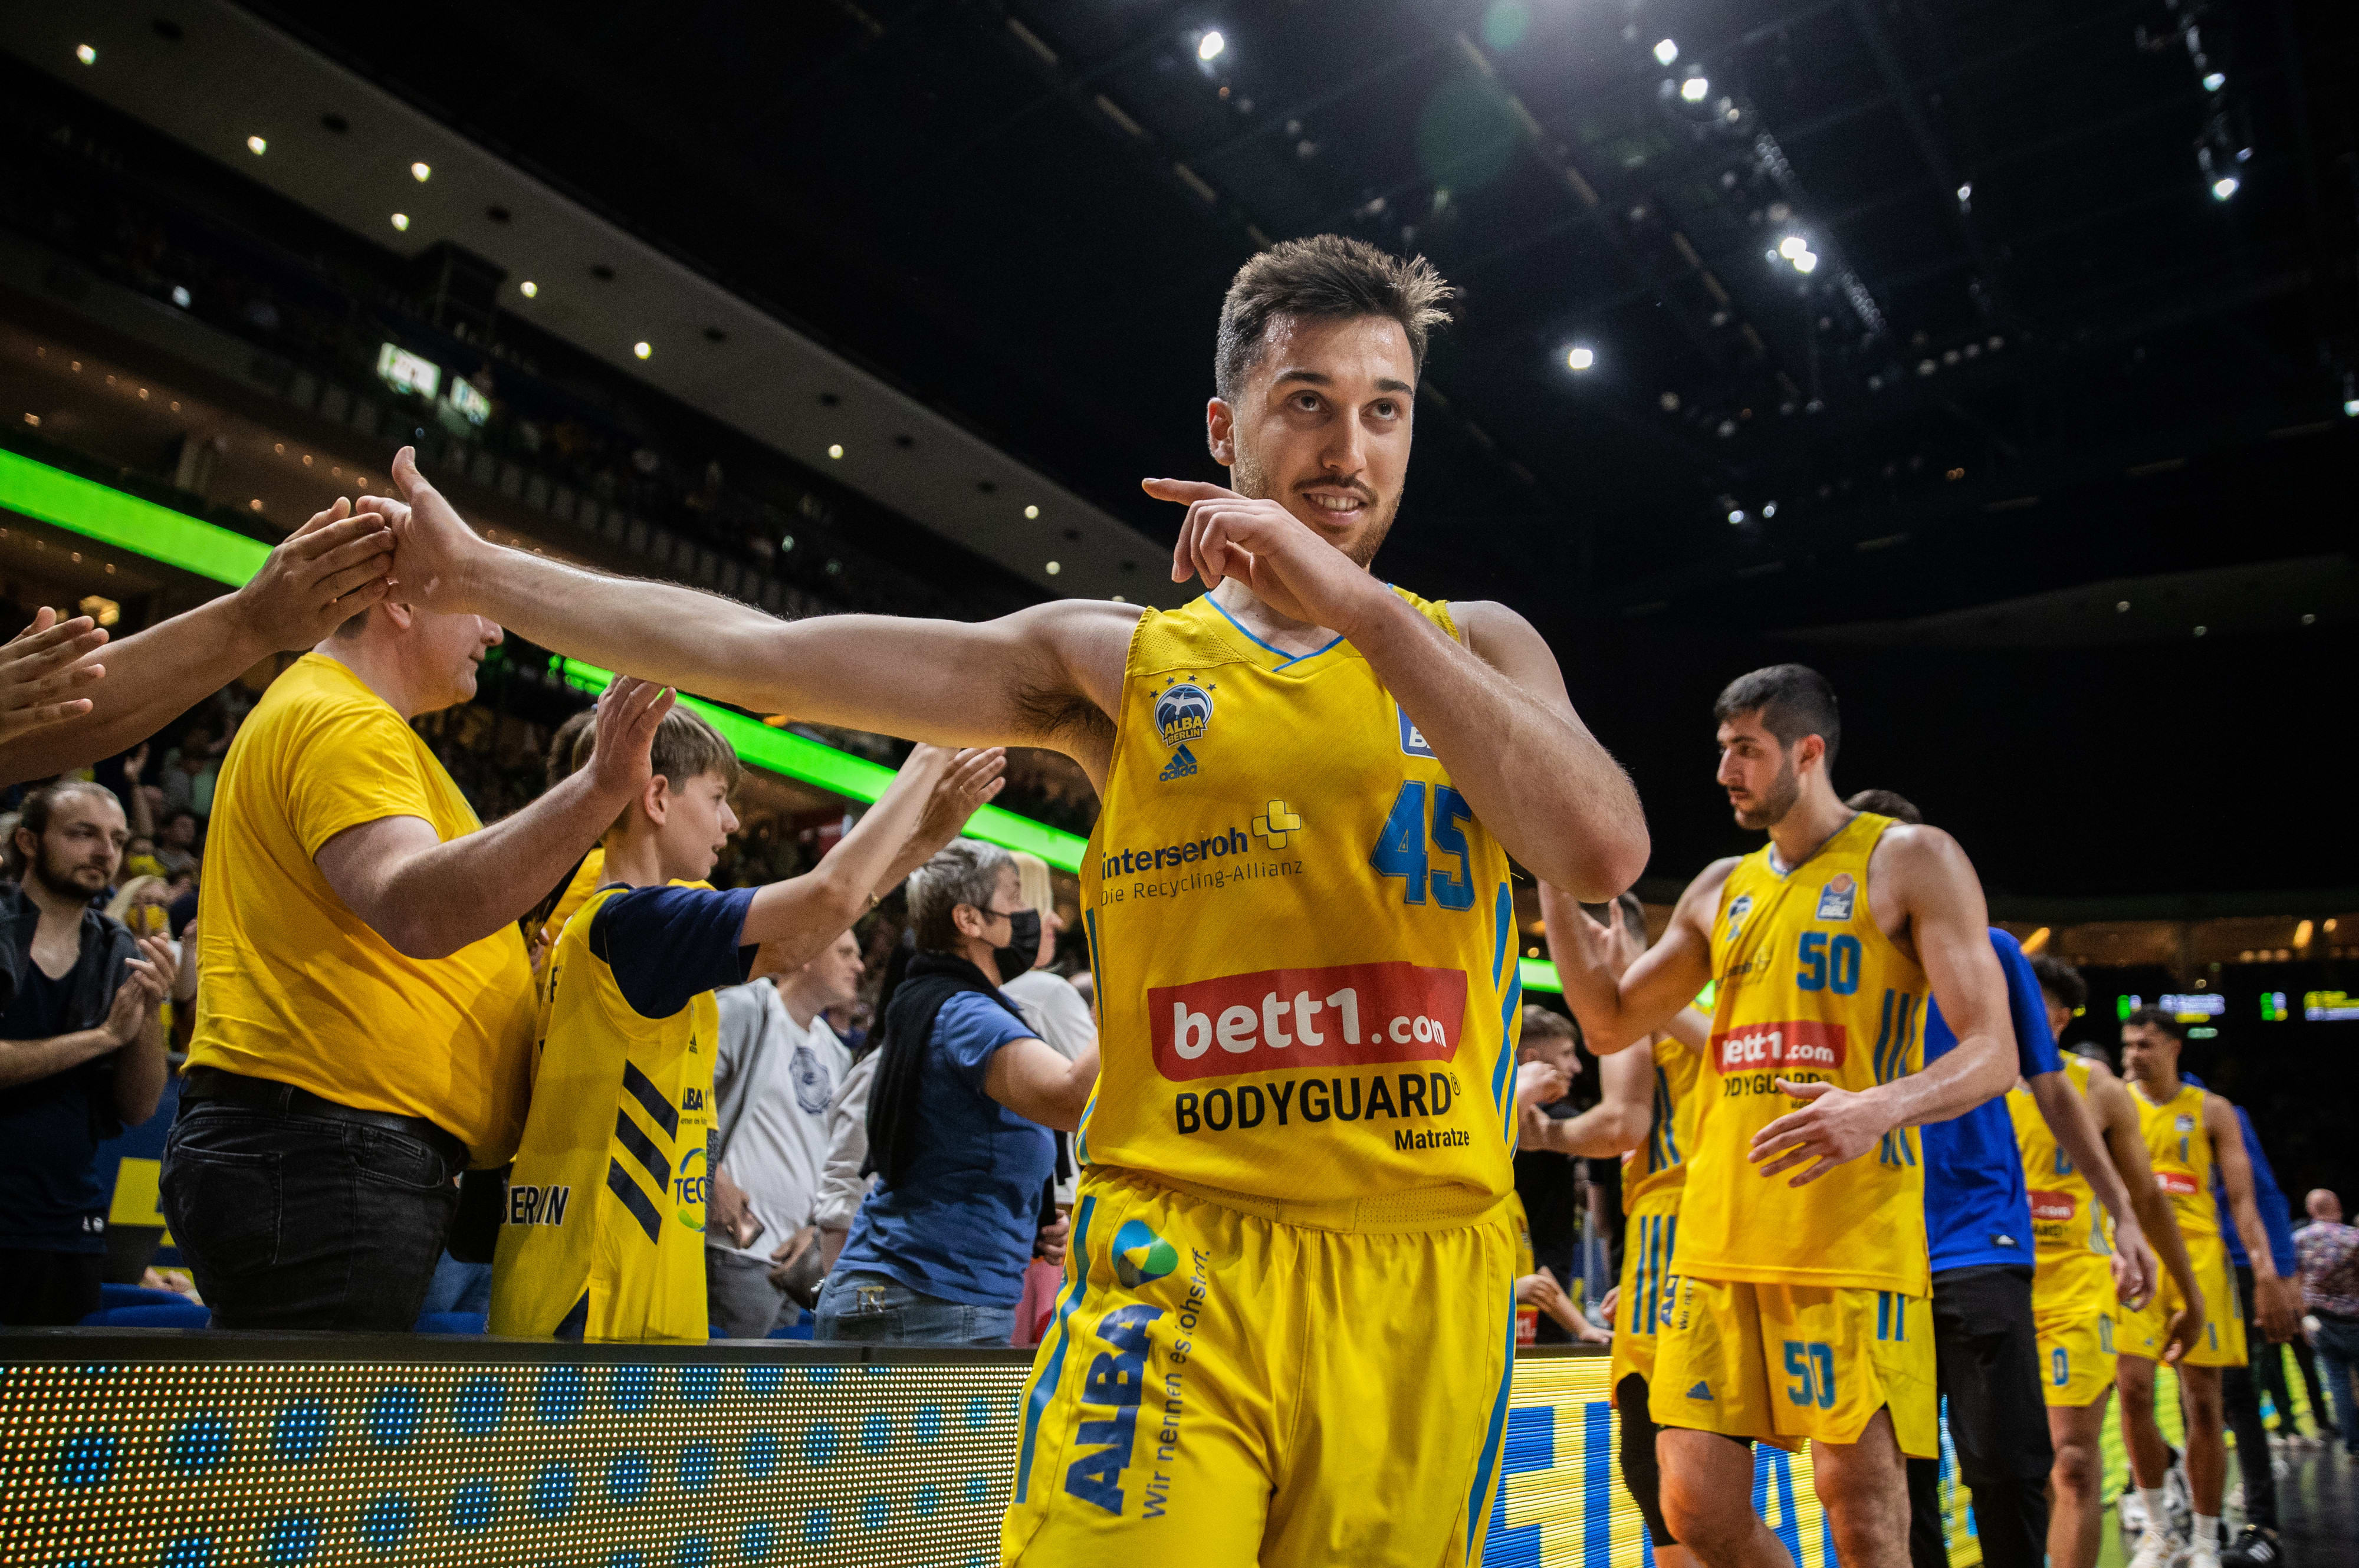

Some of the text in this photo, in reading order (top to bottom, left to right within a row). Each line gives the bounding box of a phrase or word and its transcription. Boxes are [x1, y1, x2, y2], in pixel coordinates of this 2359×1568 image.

[1164, 715, 1204, 738] ALBA
[1168, 728, 1201, 744] BERLIN
[1101, 827, 1249, 880] interseroh
[1369, 779, 1476, 912] 45
[1100, 860, 1303, 906] Die Recycling-Allianz
[1796, 931, 1862, 995] 50
[1172, 987, 1447, 1060] bett1.com
[1722, 1031, 1835, 1066] ett1.com
[1394, 1127, 1471, 1151] Matratze
[1782, 1340, 1836, 1411] 50
[1064, 1303, 1167, 1517] ALBA
[1141, 1470, 1171, 1520] Wir
[1169, 1339, 1192, 1365] es
